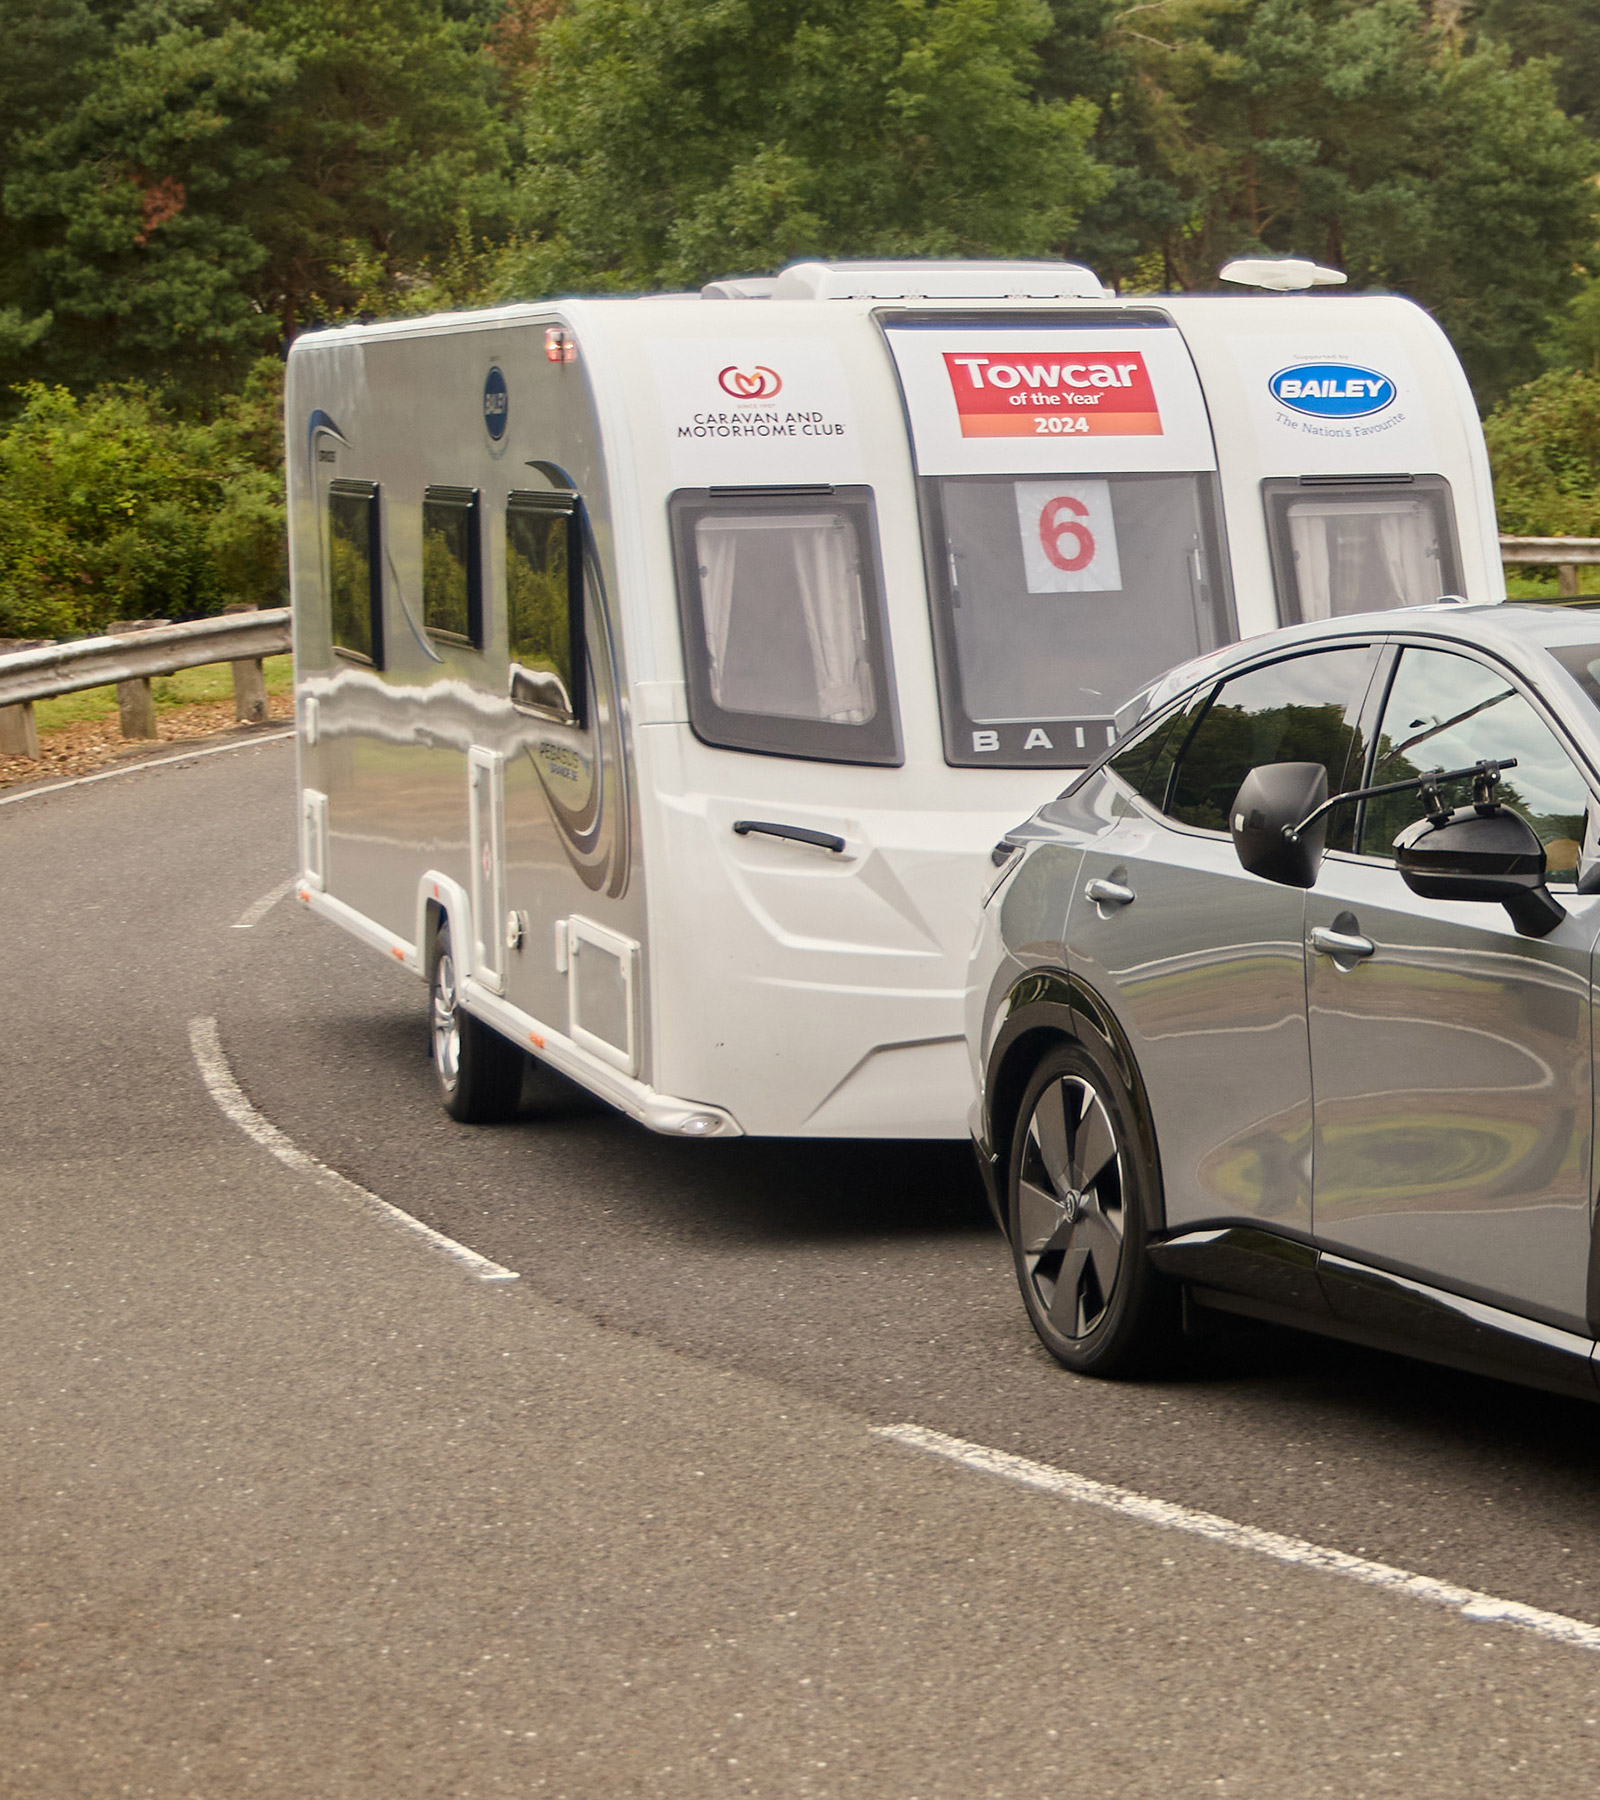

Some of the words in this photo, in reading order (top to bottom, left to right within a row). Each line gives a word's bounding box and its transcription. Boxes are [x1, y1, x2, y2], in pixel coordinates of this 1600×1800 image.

[953, 358, 1138, 389] Towcar
[1008, 392, 1027, 406] of
[1031, 391, 1061, 406] the
[1062, 392, 1101, 405] Year
[1279, 379, 1386, 399] BAILEY
[693, 412, 778, 425] CARAVAN
[785, 411, 823, 424] AND
[1033, 416, 1090, 434] 2024
[1275, 411, 1299, 430] The
[1301, 422, 1352, 438] Nation's
[1355, 412, 1406, 437] Favourite
[677, 424, 797, 438] MOTORHOME
[802, 423, 844, 436] CLUB
[1039, 496, 1095, 572] 6
